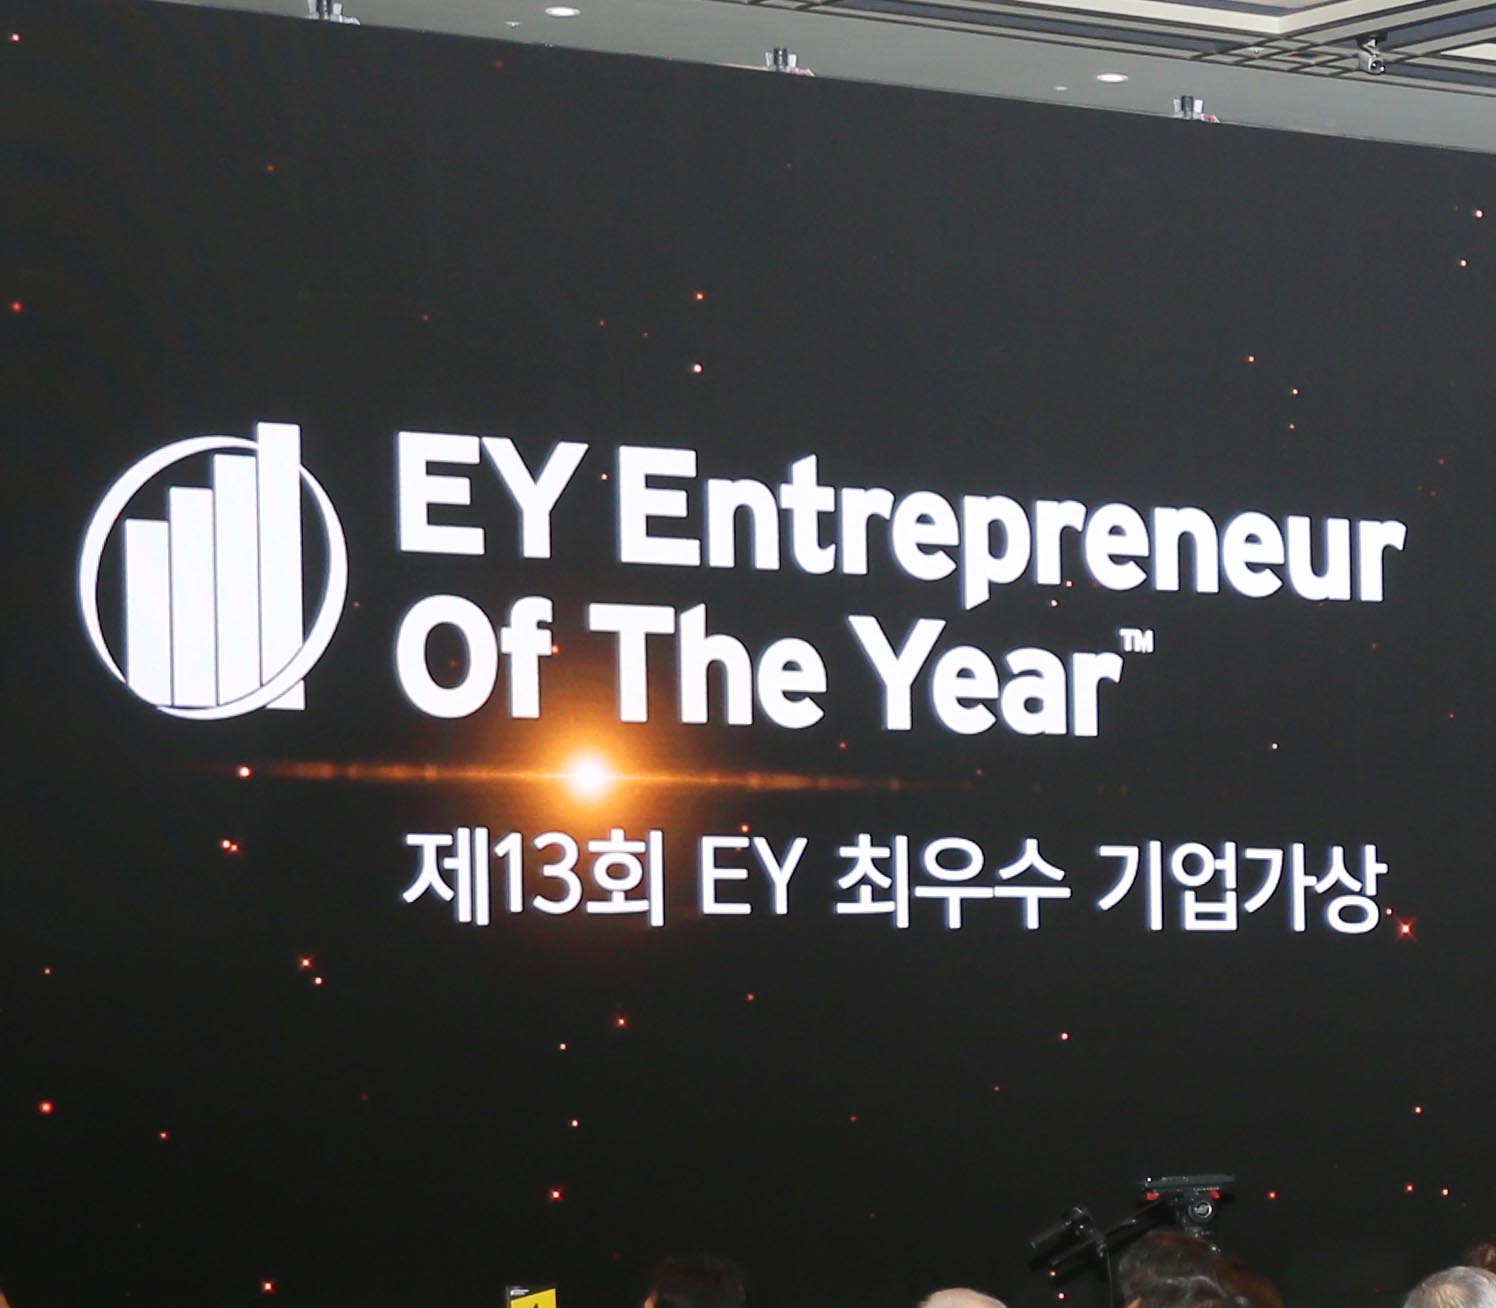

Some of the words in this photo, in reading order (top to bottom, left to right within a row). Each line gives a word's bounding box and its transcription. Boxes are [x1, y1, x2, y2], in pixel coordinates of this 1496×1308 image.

[396, 430, 589, 560] EY
[617, 445, 1407, 610] Entrepreneur
[395, 594, 554, 721] Of
[587, 602, 828, 730] The
[401, 826, 665, 928] 제13회
[701, 835, 808, 916] EY
[836, 832, 1071, 930] 최우수
[1097, 839, 1388, 934] 기업가상
